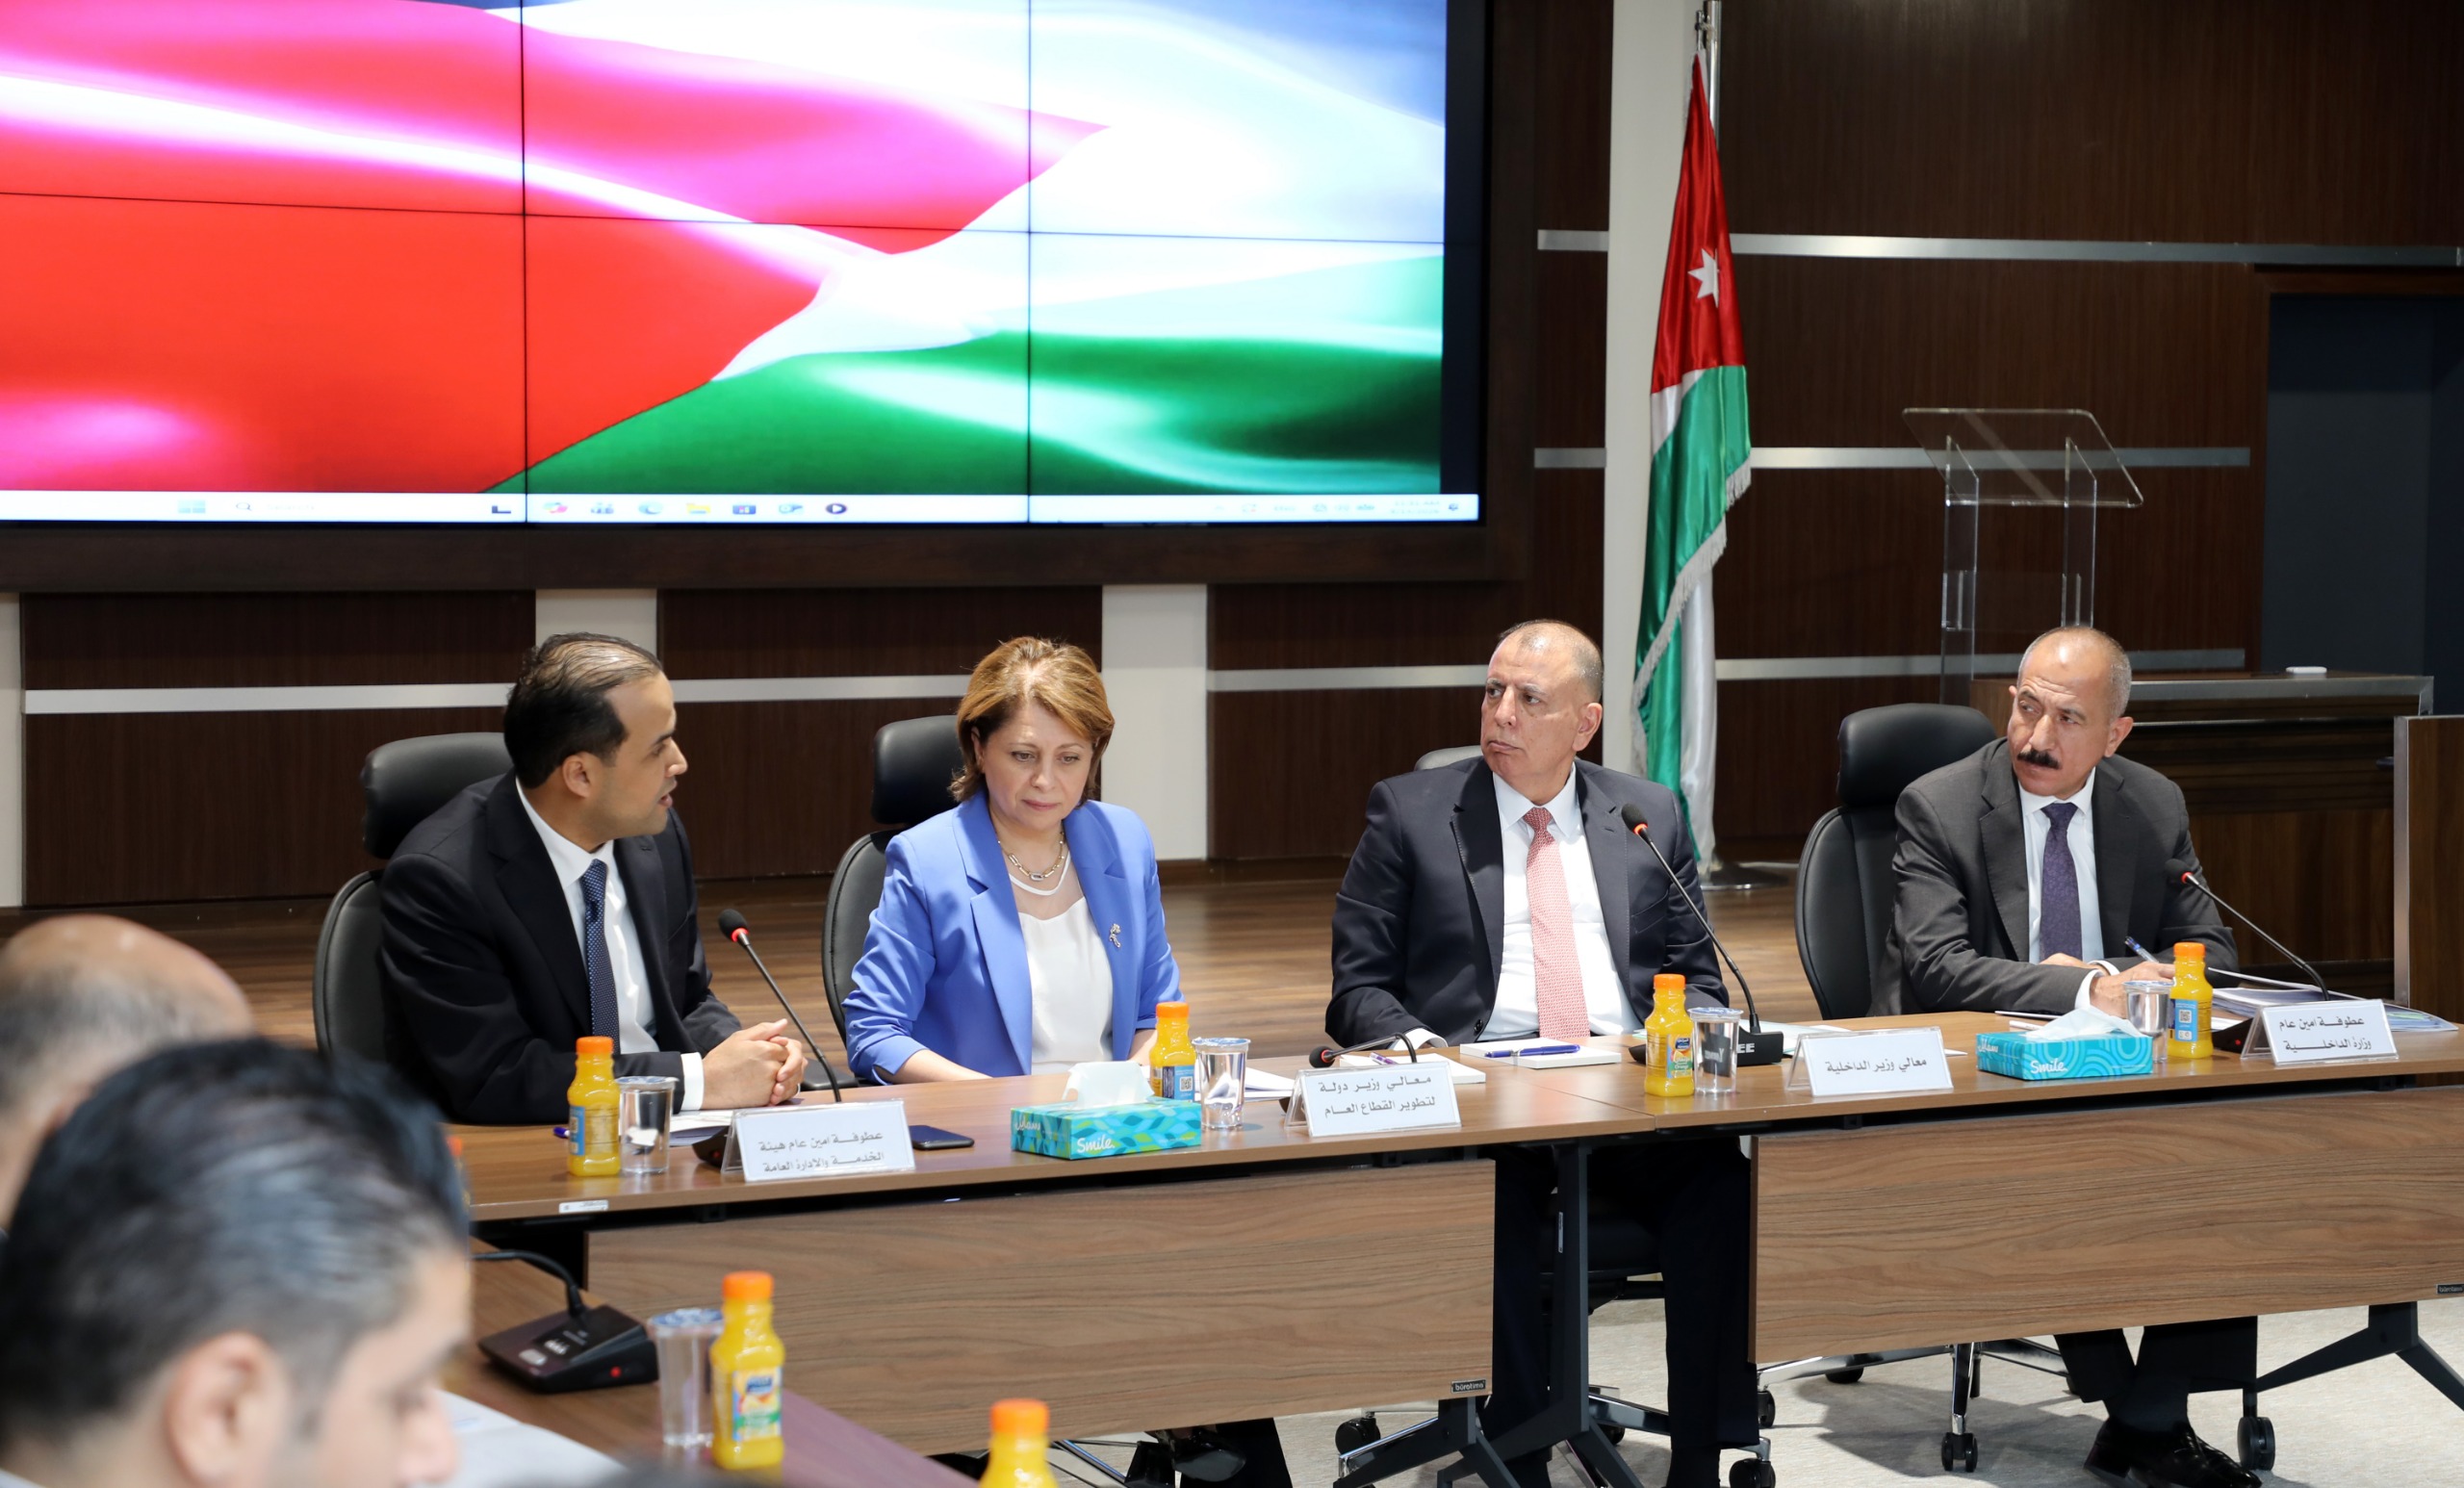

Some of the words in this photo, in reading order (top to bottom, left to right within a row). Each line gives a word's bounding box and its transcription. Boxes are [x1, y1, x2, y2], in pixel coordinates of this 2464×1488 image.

[2279, 1019, 2296, 1031] عام
[1825, 1060, 1871, 1074] الداخلية
[1873, 1058, 1895, 1072] وزير
[1898, 1057, 1927, 1072] معالي
[2030, 1058, 2067, 1074] Smile
[1318, 1081, 1348, 1094] دولة
[1354, 1078, 1380, 1091] وزير
[1361, 1099, 1396, 1116] القطاع
[1399, 1095, 1435, 1112] لتطوير
[788, 1139, 808, 1150] عام
[810, 1136, 831, 1149] امين
[1076, 1134, 1115, 1153] Smile
[763, 1161, 793, 1172] العامة
